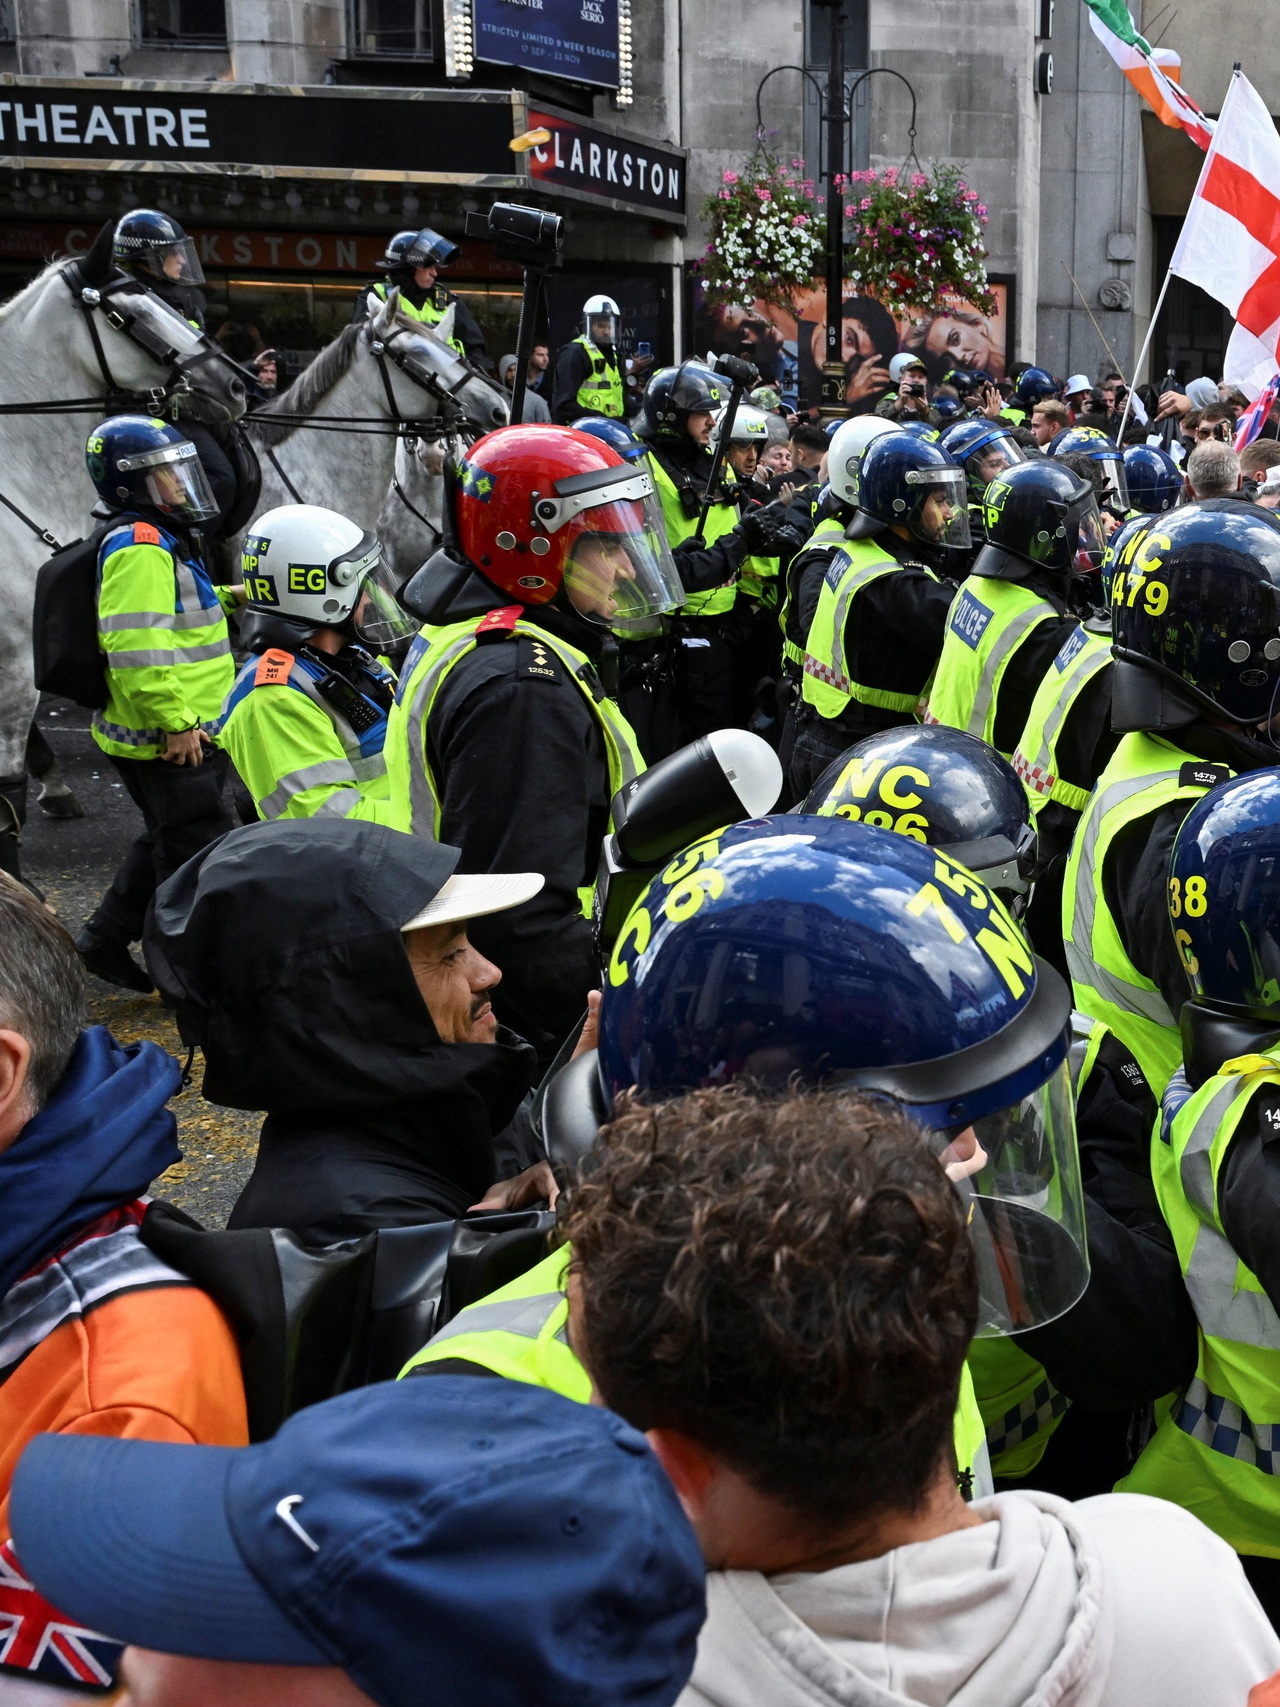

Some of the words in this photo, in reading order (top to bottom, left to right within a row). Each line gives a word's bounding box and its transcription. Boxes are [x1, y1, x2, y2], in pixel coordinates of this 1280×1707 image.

[582, 0, 602, 14] JACK
[580, 10, 605, 24] SERIO
[481, 23, 520, 39] STRICTLY
[521, 31, 554, 46] LIMITED
[556, 39, 562, 48] 9
[563, 42, 585, 53] WEEK
[586, 46, 617, 60] SEASON
[531, 46, 545, 56] SEP
[564, 53, 581, 64] NOV
[1119, 529, 1172, 573] NC
[290, 567, 326, 591] EG
[527, 666, 555, 677] 12532
[831, 758, 931, 810] NC
[1193, 771, 1217, 780] 1479
